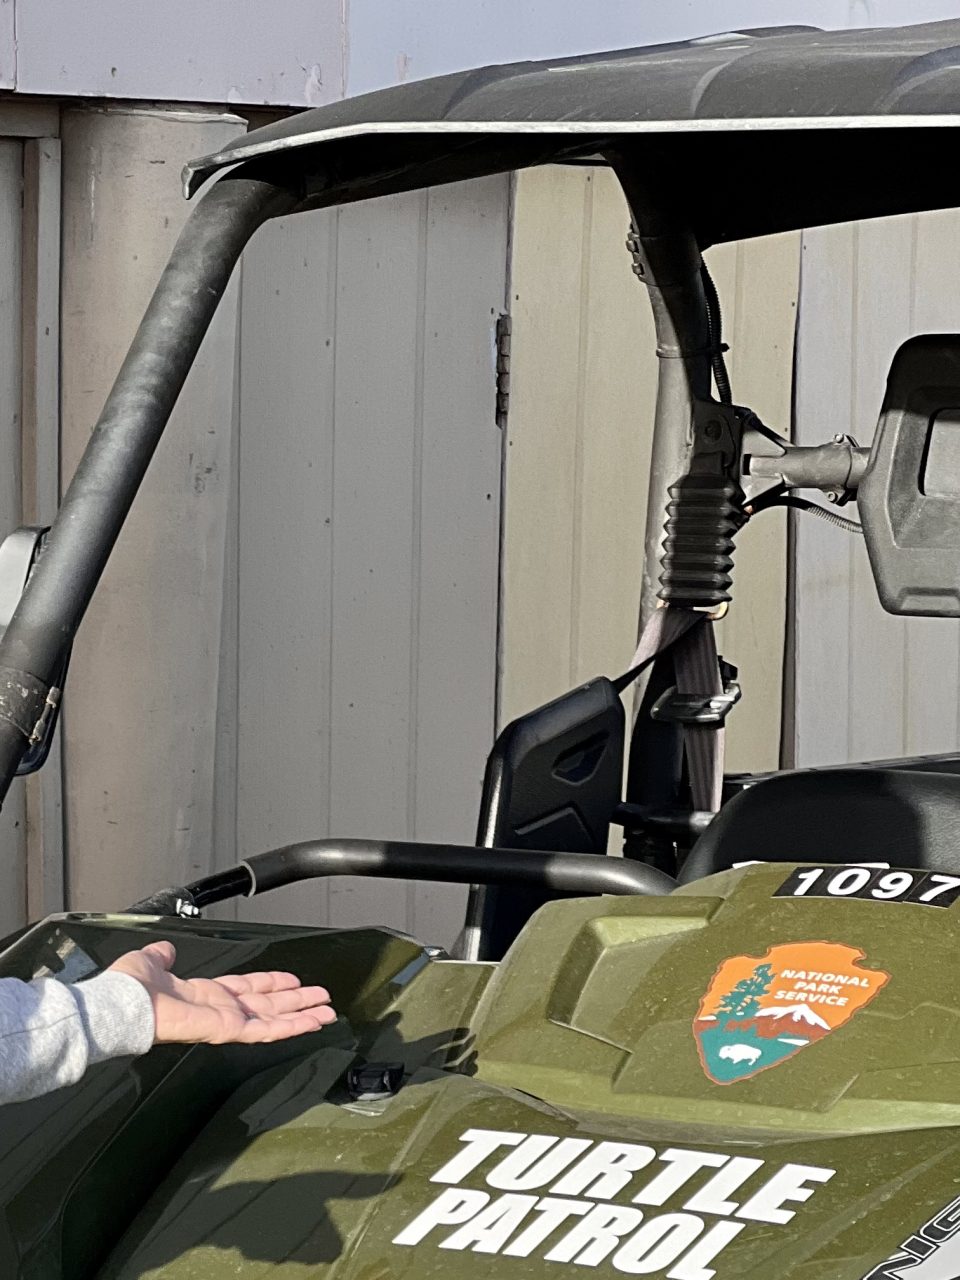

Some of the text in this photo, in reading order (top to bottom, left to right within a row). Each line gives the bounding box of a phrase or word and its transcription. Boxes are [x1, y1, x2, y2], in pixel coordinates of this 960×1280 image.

[793, 868, 960, 902] 1097
[780, 969, 870, 988] NATIONAL
[793, 981, 843, 994] PARK
[773, 990, 849, 1007] SERVICE
[429, 1128, 837, 1225] TURTLE
